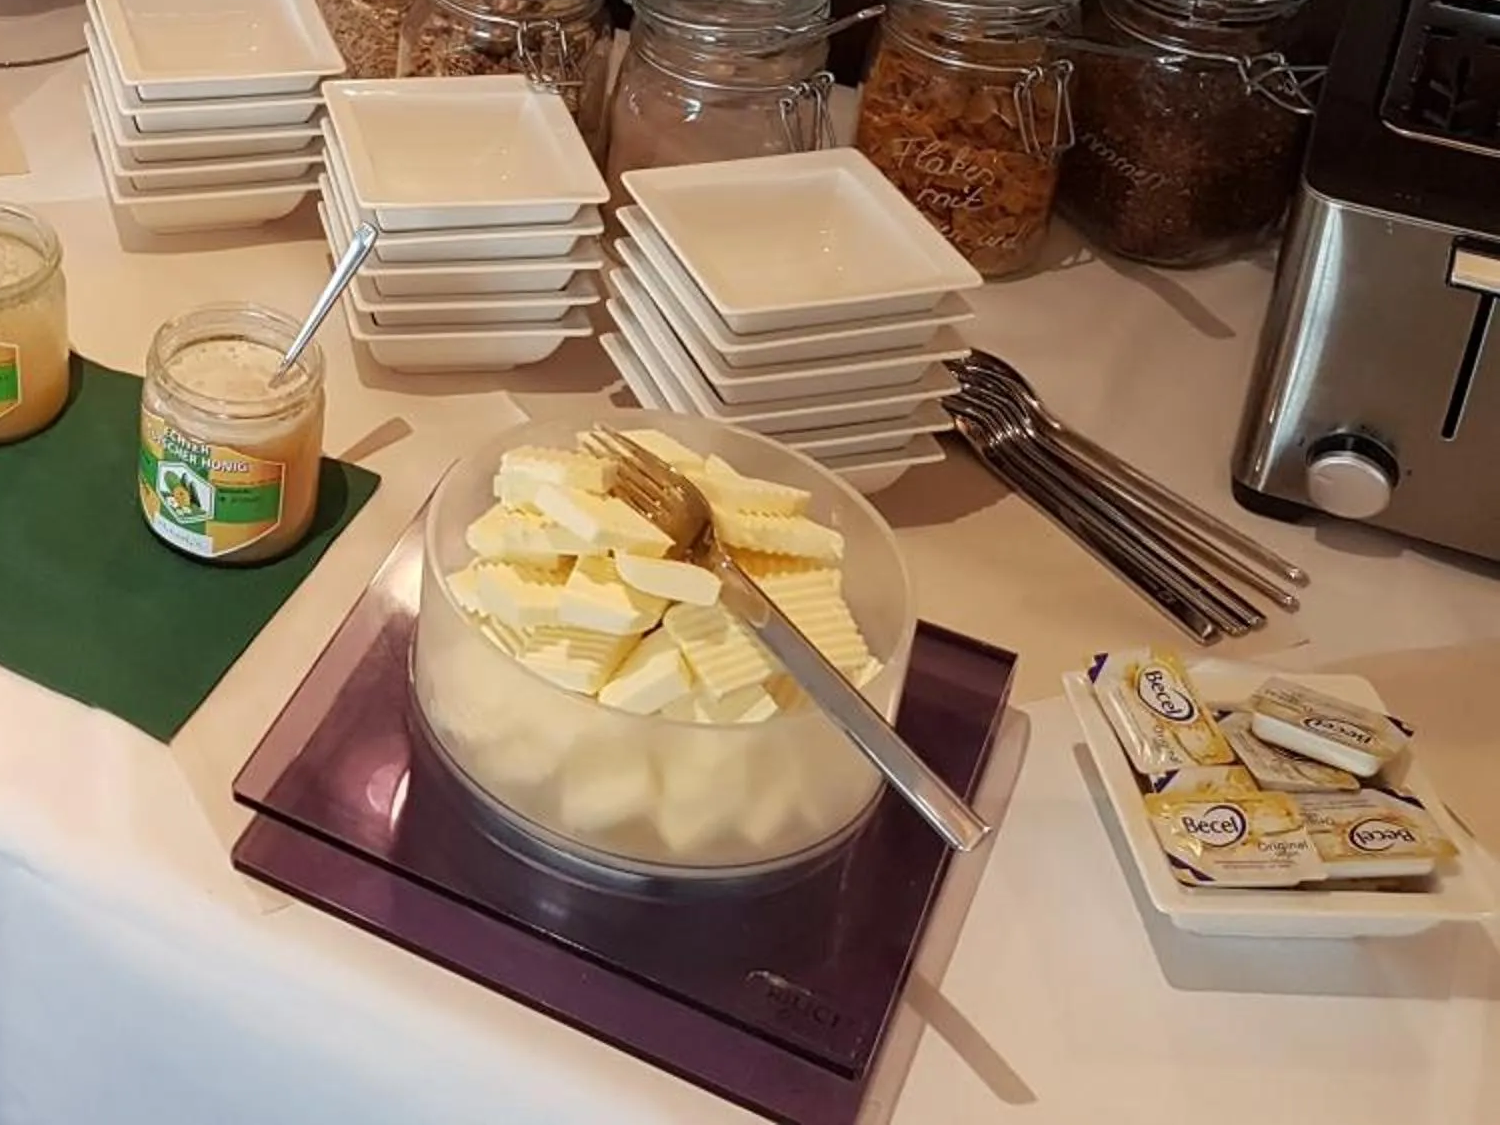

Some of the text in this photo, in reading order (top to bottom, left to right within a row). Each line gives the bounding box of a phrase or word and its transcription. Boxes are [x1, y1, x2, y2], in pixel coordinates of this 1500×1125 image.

[201, 458, 250, 473] HONIG
[1143, 670, 1183, 715] Becel
[1181, 815, 1240, 836] Becel
[1355, 825, 1417, 845] Becel
